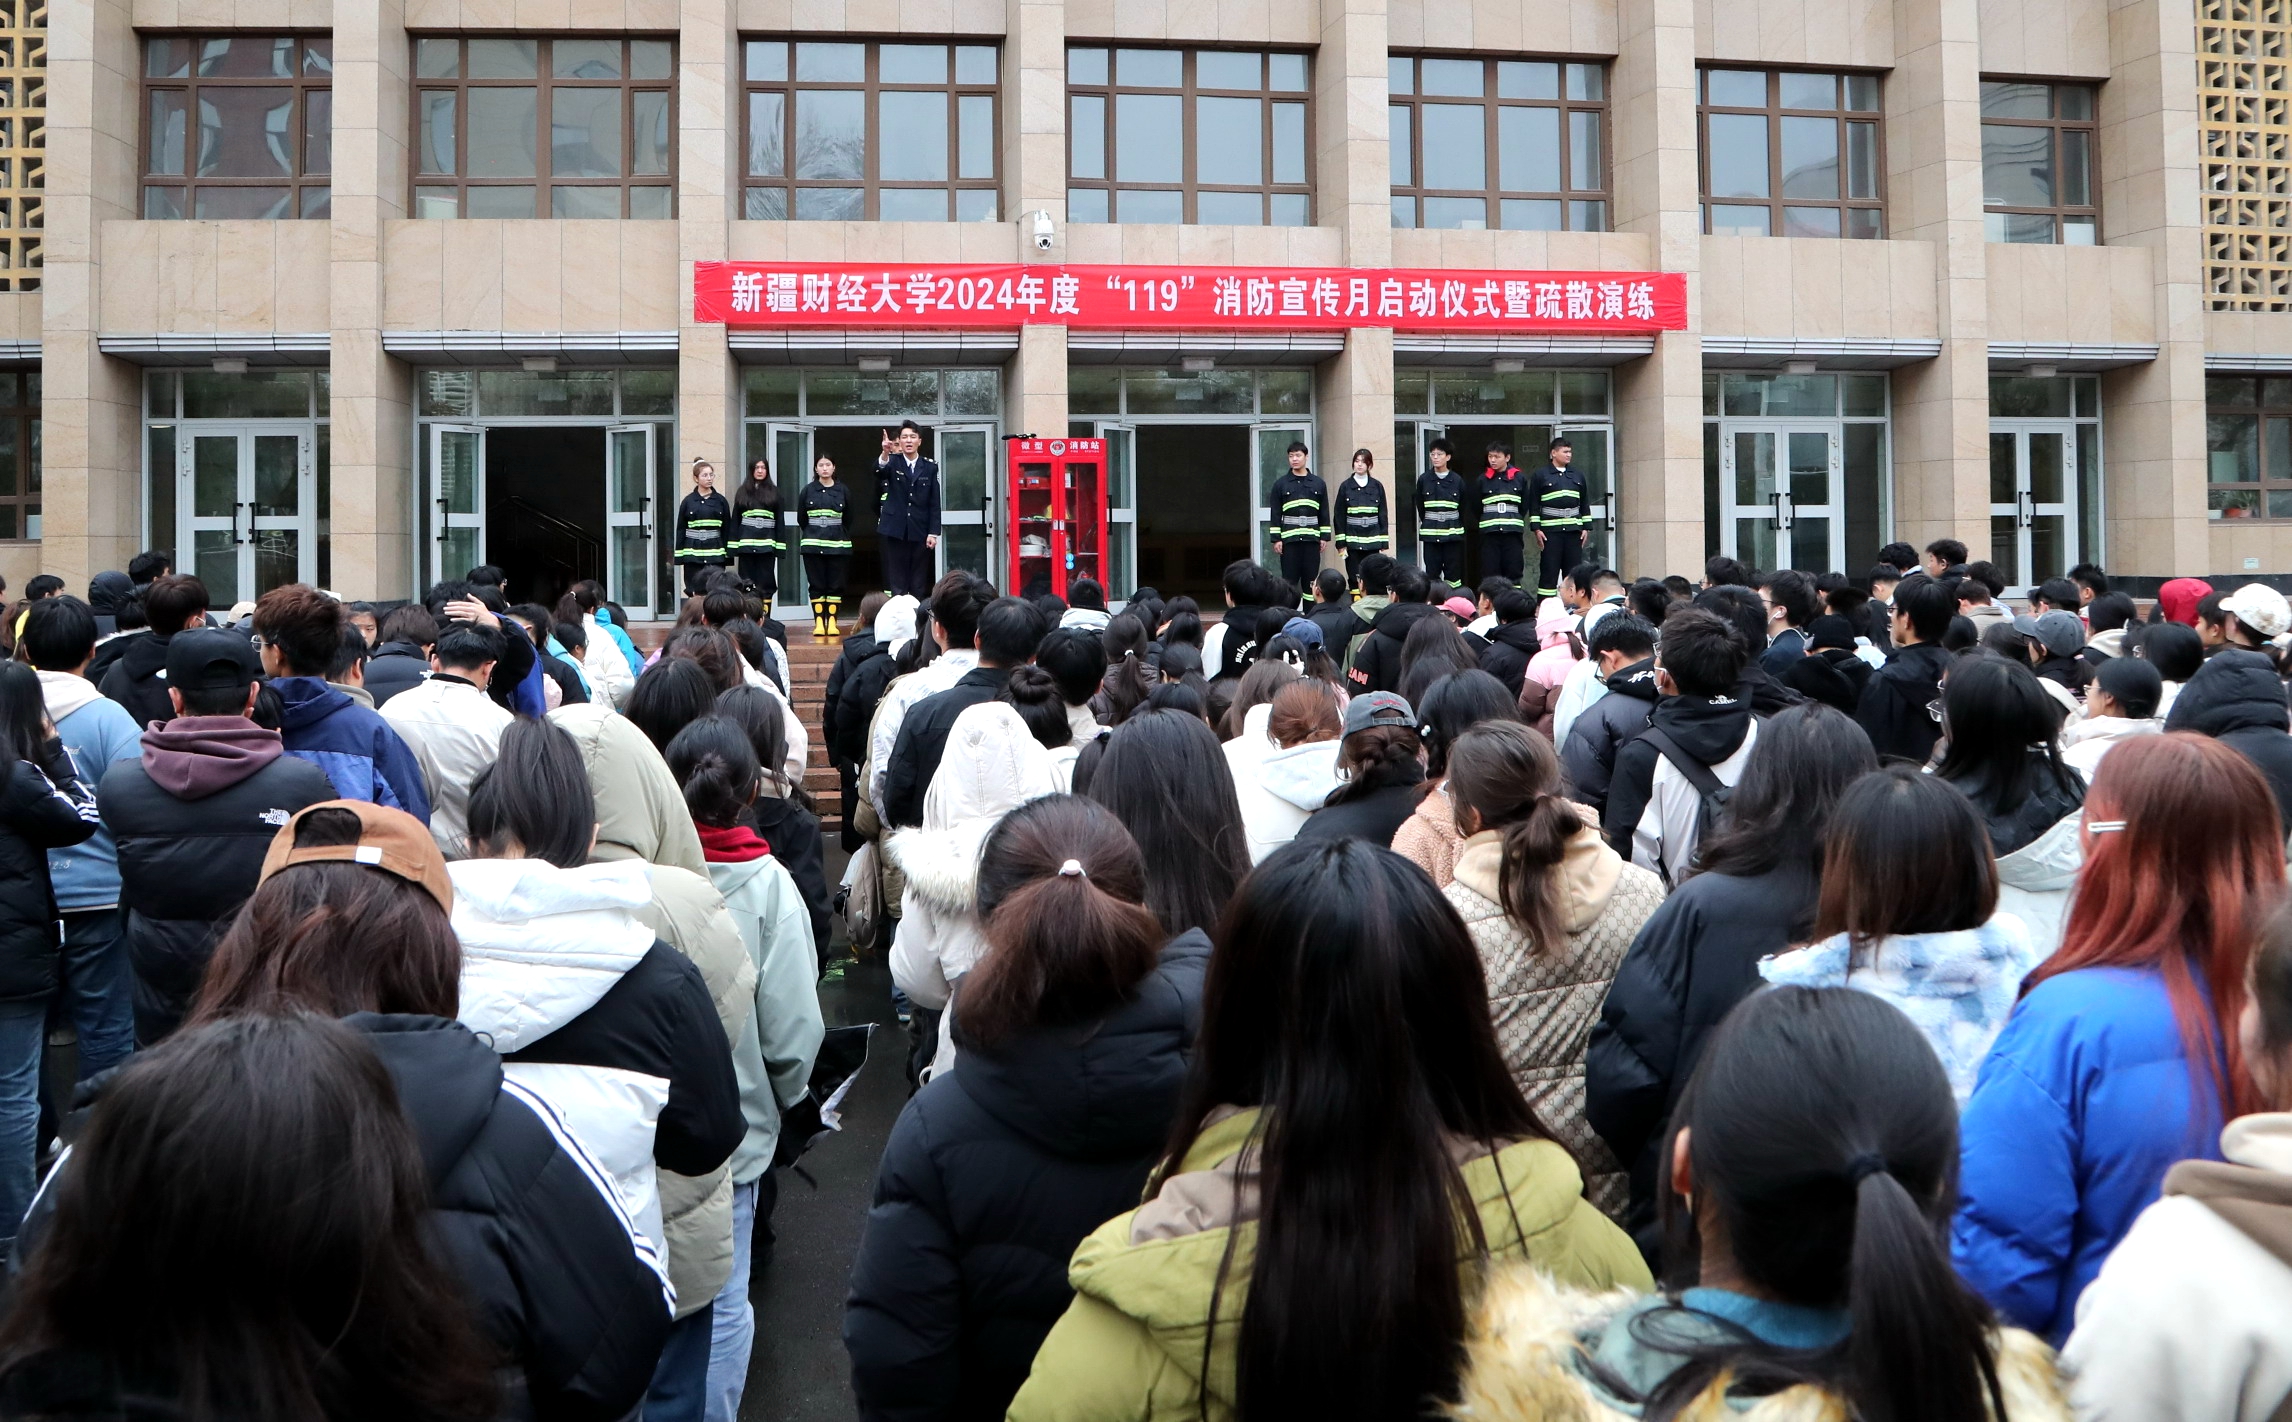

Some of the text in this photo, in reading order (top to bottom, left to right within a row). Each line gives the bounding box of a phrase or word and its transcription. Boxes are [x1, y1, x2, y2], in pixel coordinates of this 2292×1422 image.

[1070, 441, 1100, 450] 消防站
[259, 812, 282, 820] NORTH
